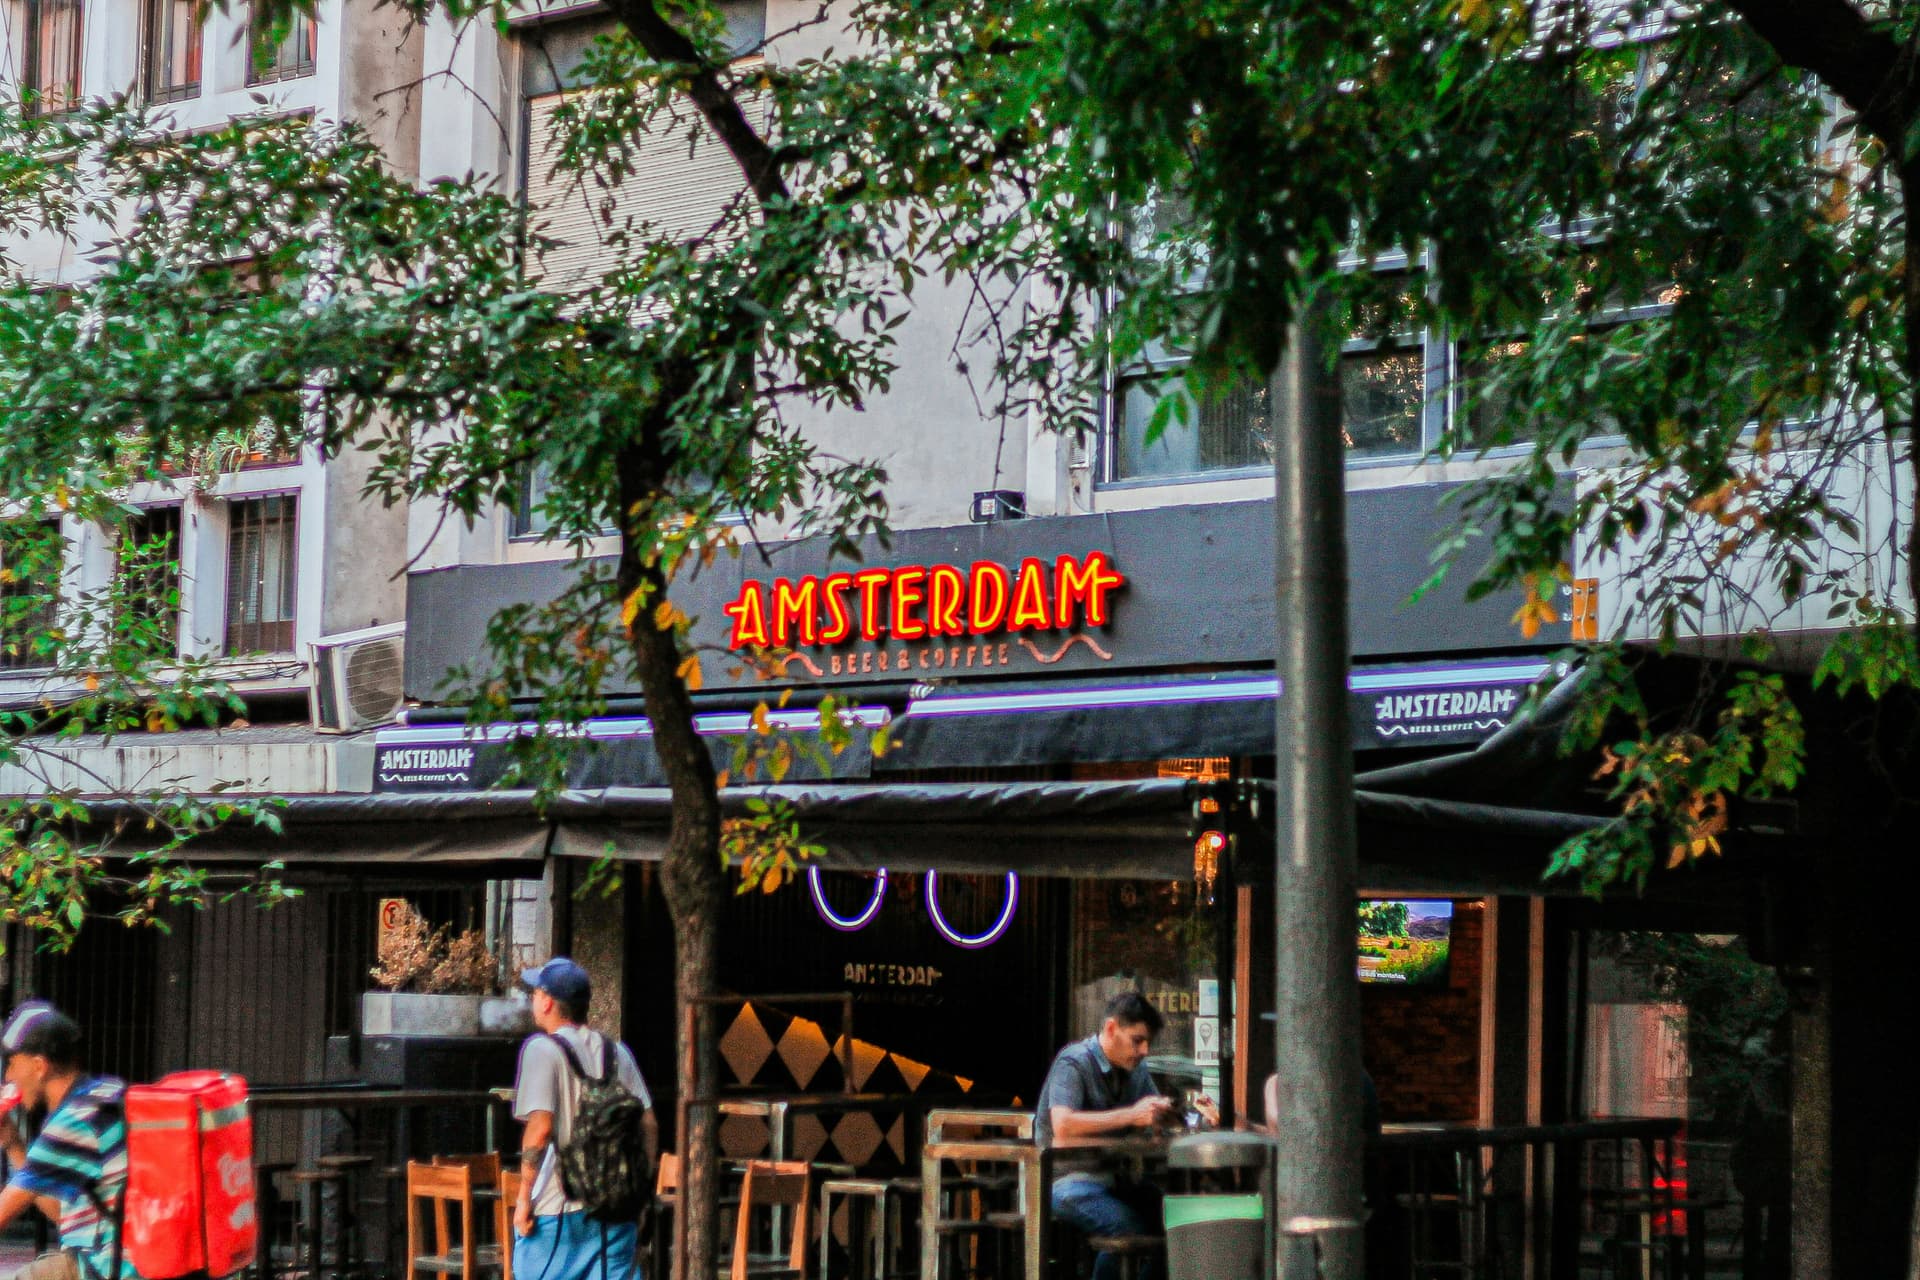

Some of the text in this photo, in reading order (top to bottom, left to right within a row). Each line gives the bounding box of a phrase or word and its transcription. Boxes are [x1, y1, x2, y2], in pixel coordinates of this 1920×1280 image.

[723, 550, 1123, 651] AMSTERDAM
[831, 643, 1009, 675] BEER & COFFEE
[1375, 689, 1516, 720] AMSTERDAM
[381, 748, 474, 769] AMSTERDAM
